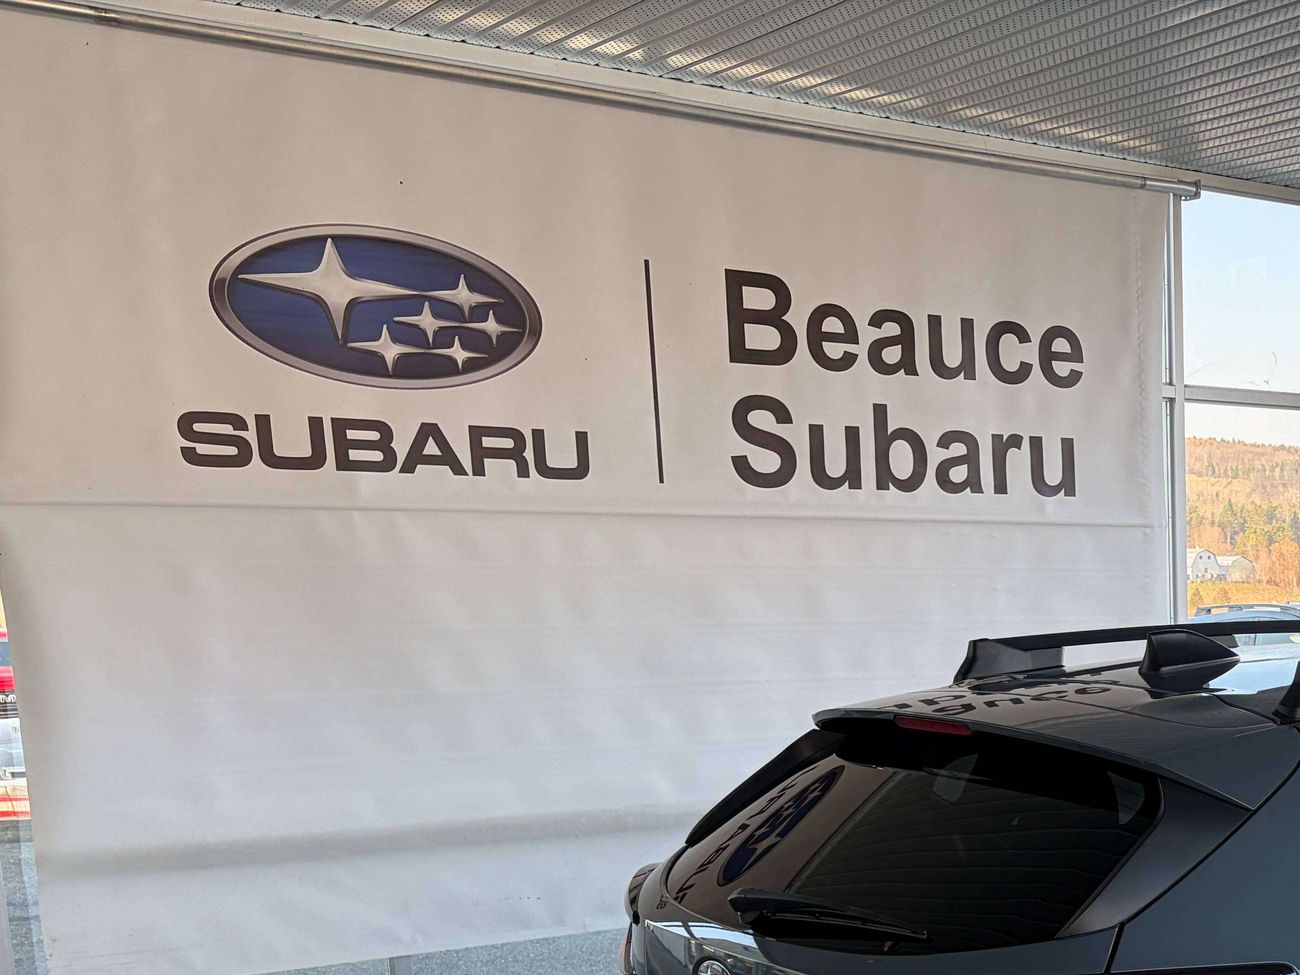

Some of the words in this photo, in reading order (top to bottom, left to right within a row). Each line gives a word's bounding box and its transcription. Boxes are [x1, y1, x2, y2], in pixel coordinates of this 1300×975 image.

[724, 268, 1084, 389] Beauce
[176, 410, 590, 481] SUBARU
[730, 394, 1076, 498] Subaru
